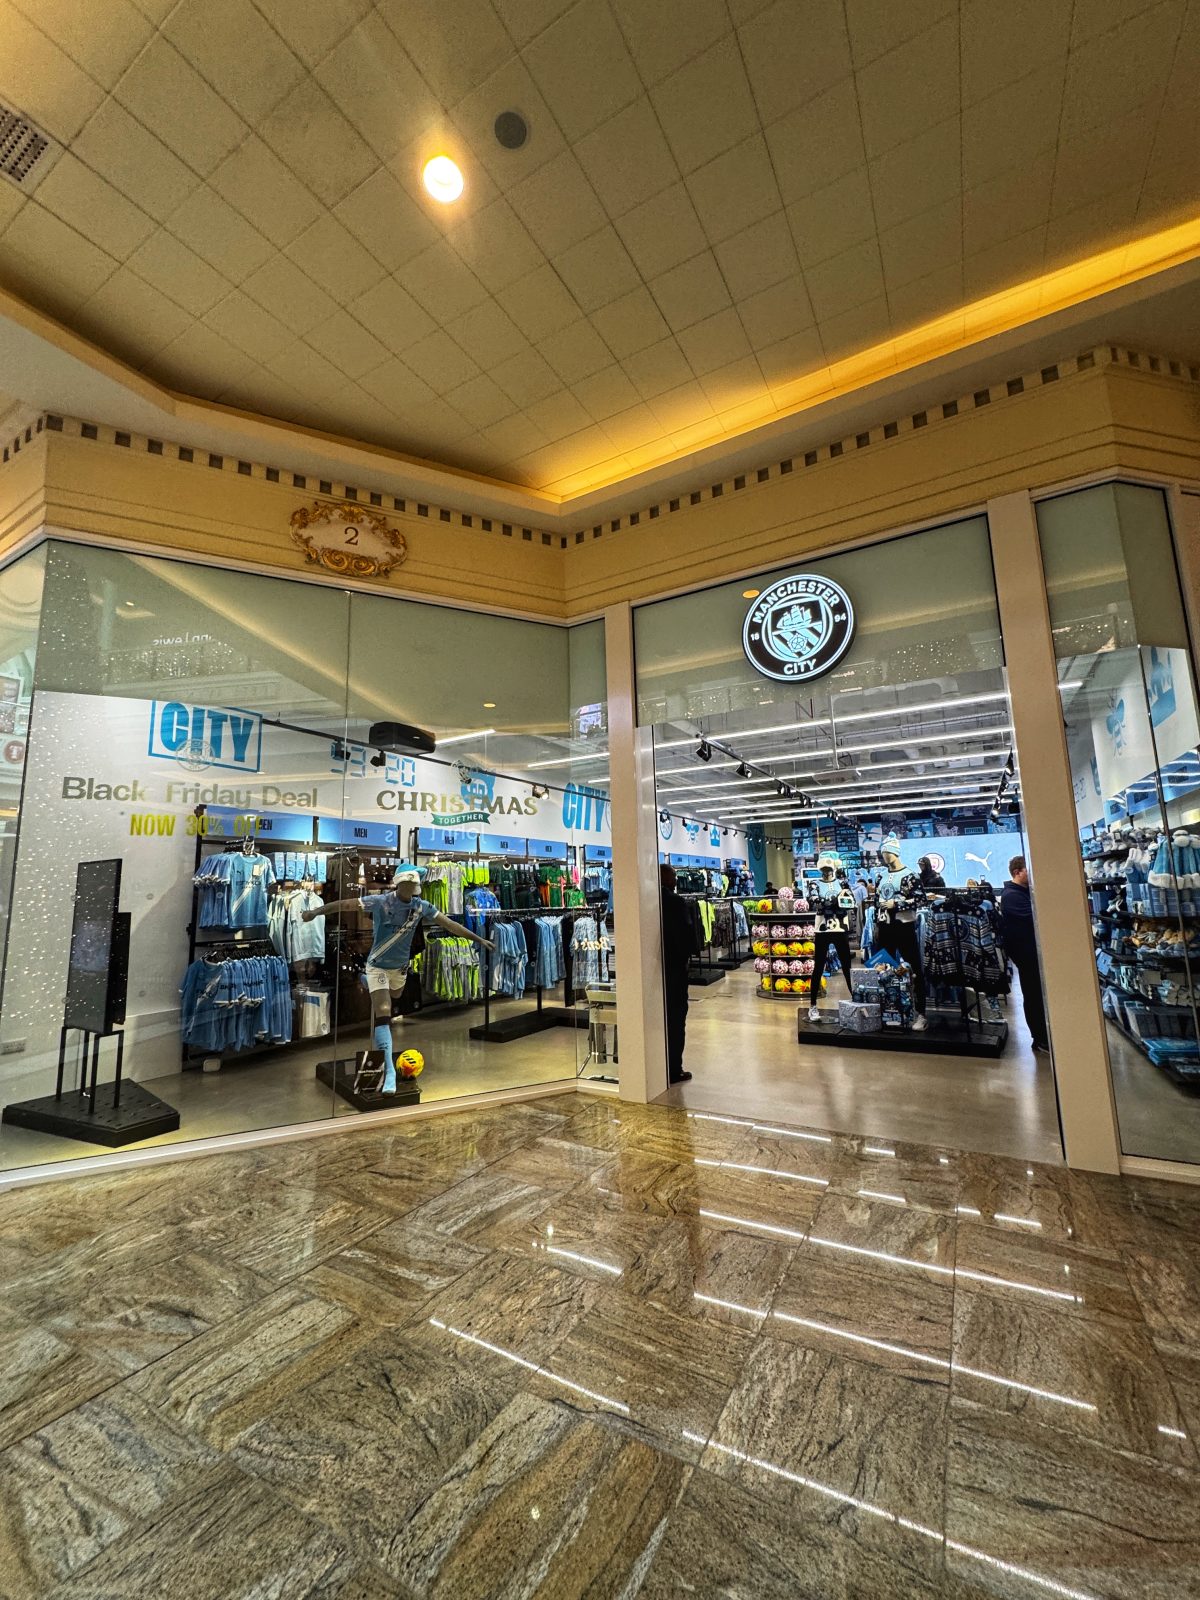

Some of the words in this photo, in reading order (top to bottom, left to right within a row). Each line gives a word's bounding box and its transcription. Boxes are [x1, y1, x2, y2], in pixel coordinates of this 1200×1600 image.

[344, 526, 358, 546] 2
[752, 580, 840, 624] MANCHESTER
[750, 632, 760, 641] 18
[834, 612, 847, 623] 94
[783, 658, 817, 675] CITY
[160, 701, 254, 763] CITY
[61, 776, 146, 802] Black
[166, 781, 251, 809] Friday
[262, 785, 318, 808] Deal
[376, 789, 539, 816] CHRISTMAS
[439, 813, 484, 825] TOGETHER
[562, 782, 607, 832] CITY
[130, 813, 177, 837] NOW
[186, 816, 225, 837] 30%
[354, 827, 368, 838] MEN
